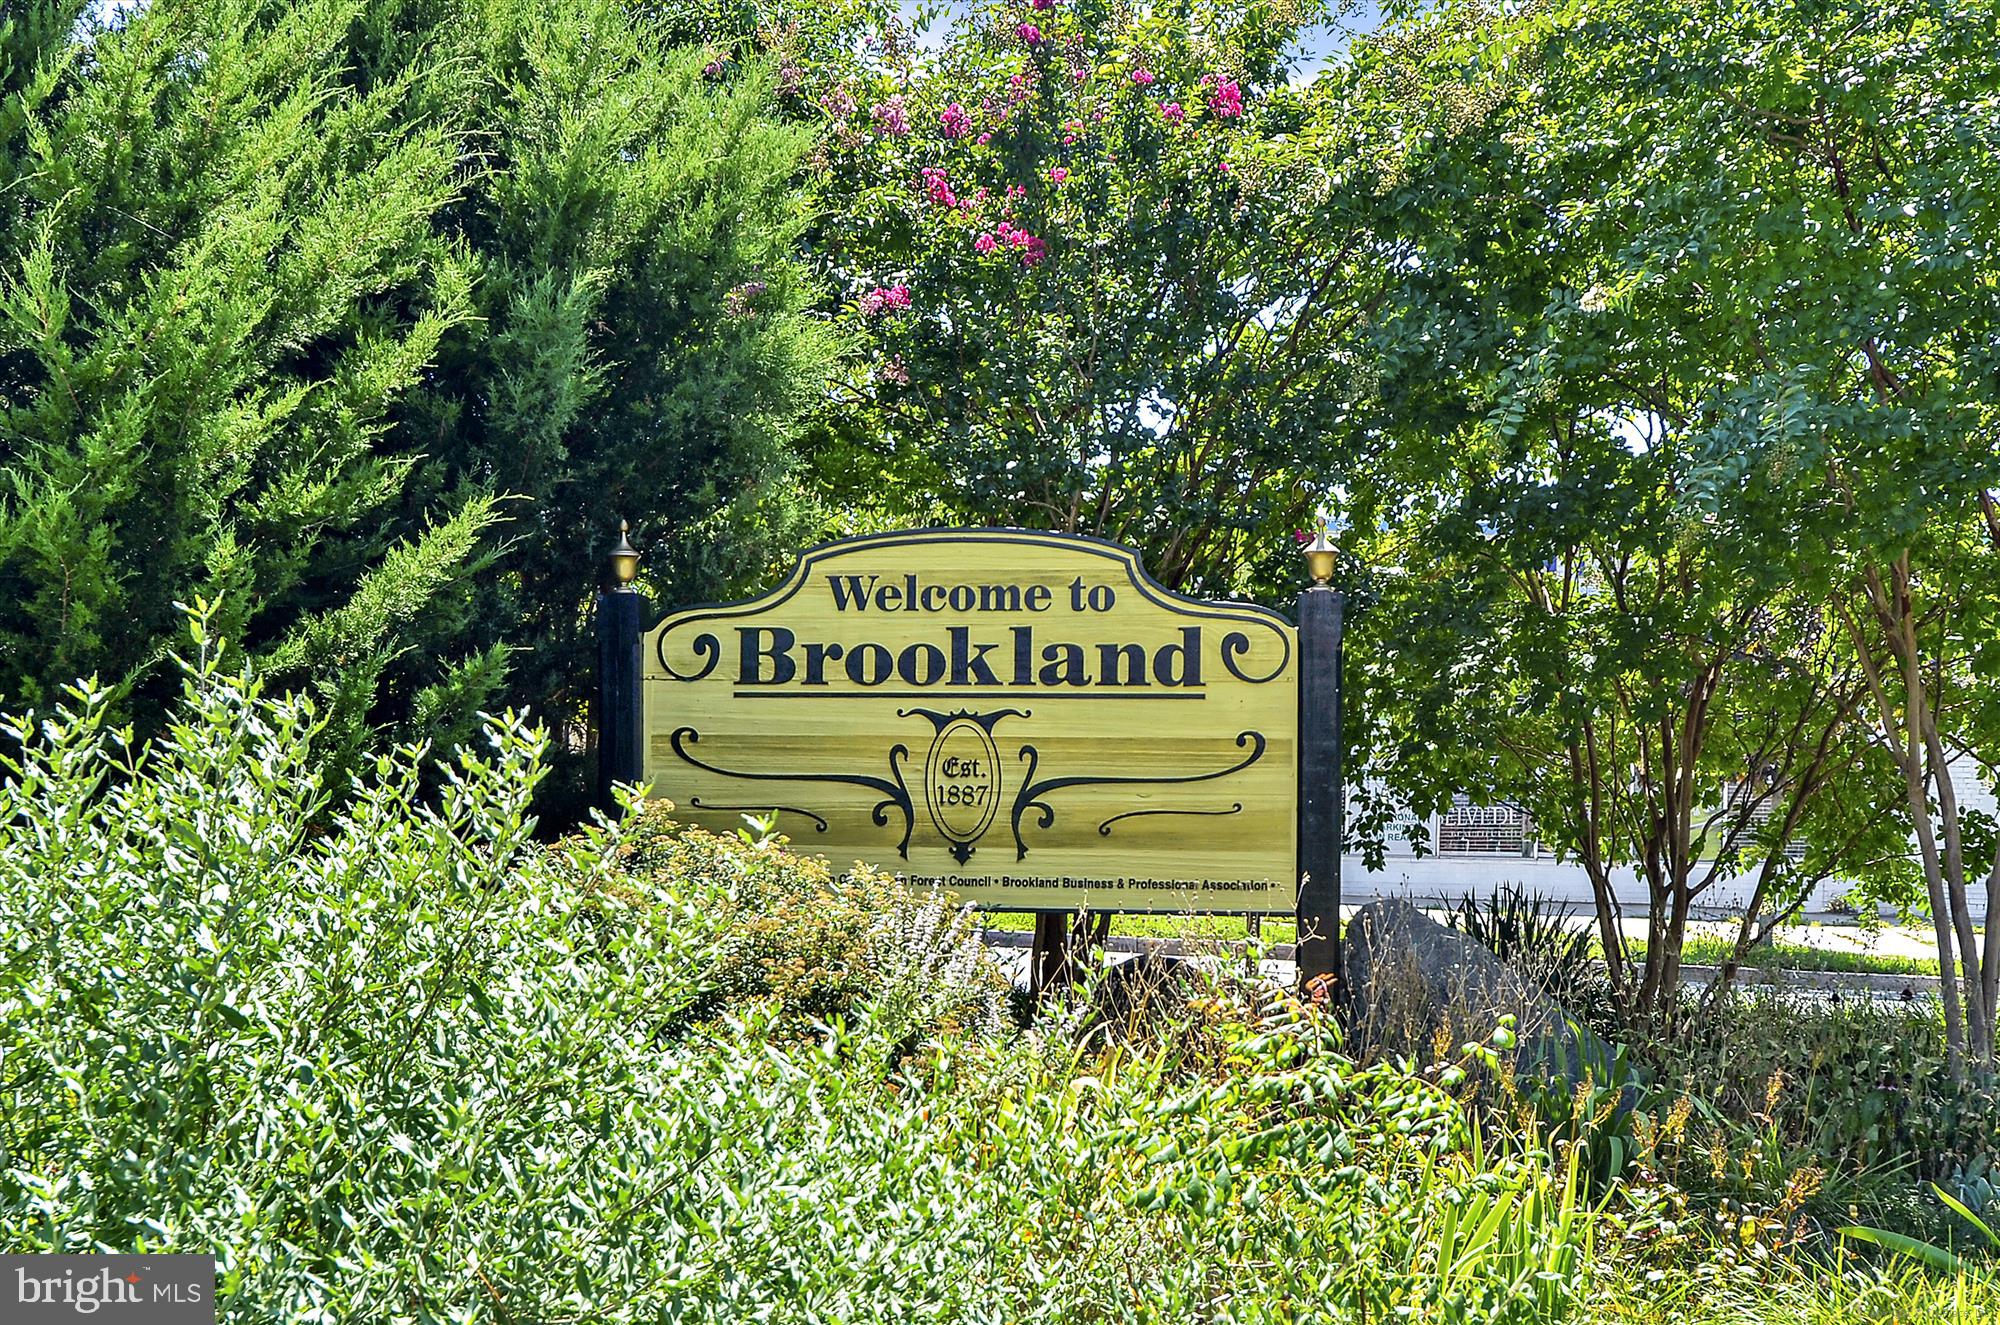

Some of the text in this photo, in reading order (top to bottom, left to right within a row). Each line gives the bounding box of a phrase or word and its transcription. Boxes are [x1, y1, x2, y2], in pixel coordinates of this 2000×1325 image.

[825, 574, 1116, 612] Welcome to
[733, 625, 1206, 687] Brookland
[942, 756, 987, 778] Est.
[937, 785, 989, 807] 1887
[948, 875, 991, 887] Council
[1002, 876, 1059, 888] Brookland
[1062, 877, 1114, 889] Business
[1116, 878, 1125, 889] &
